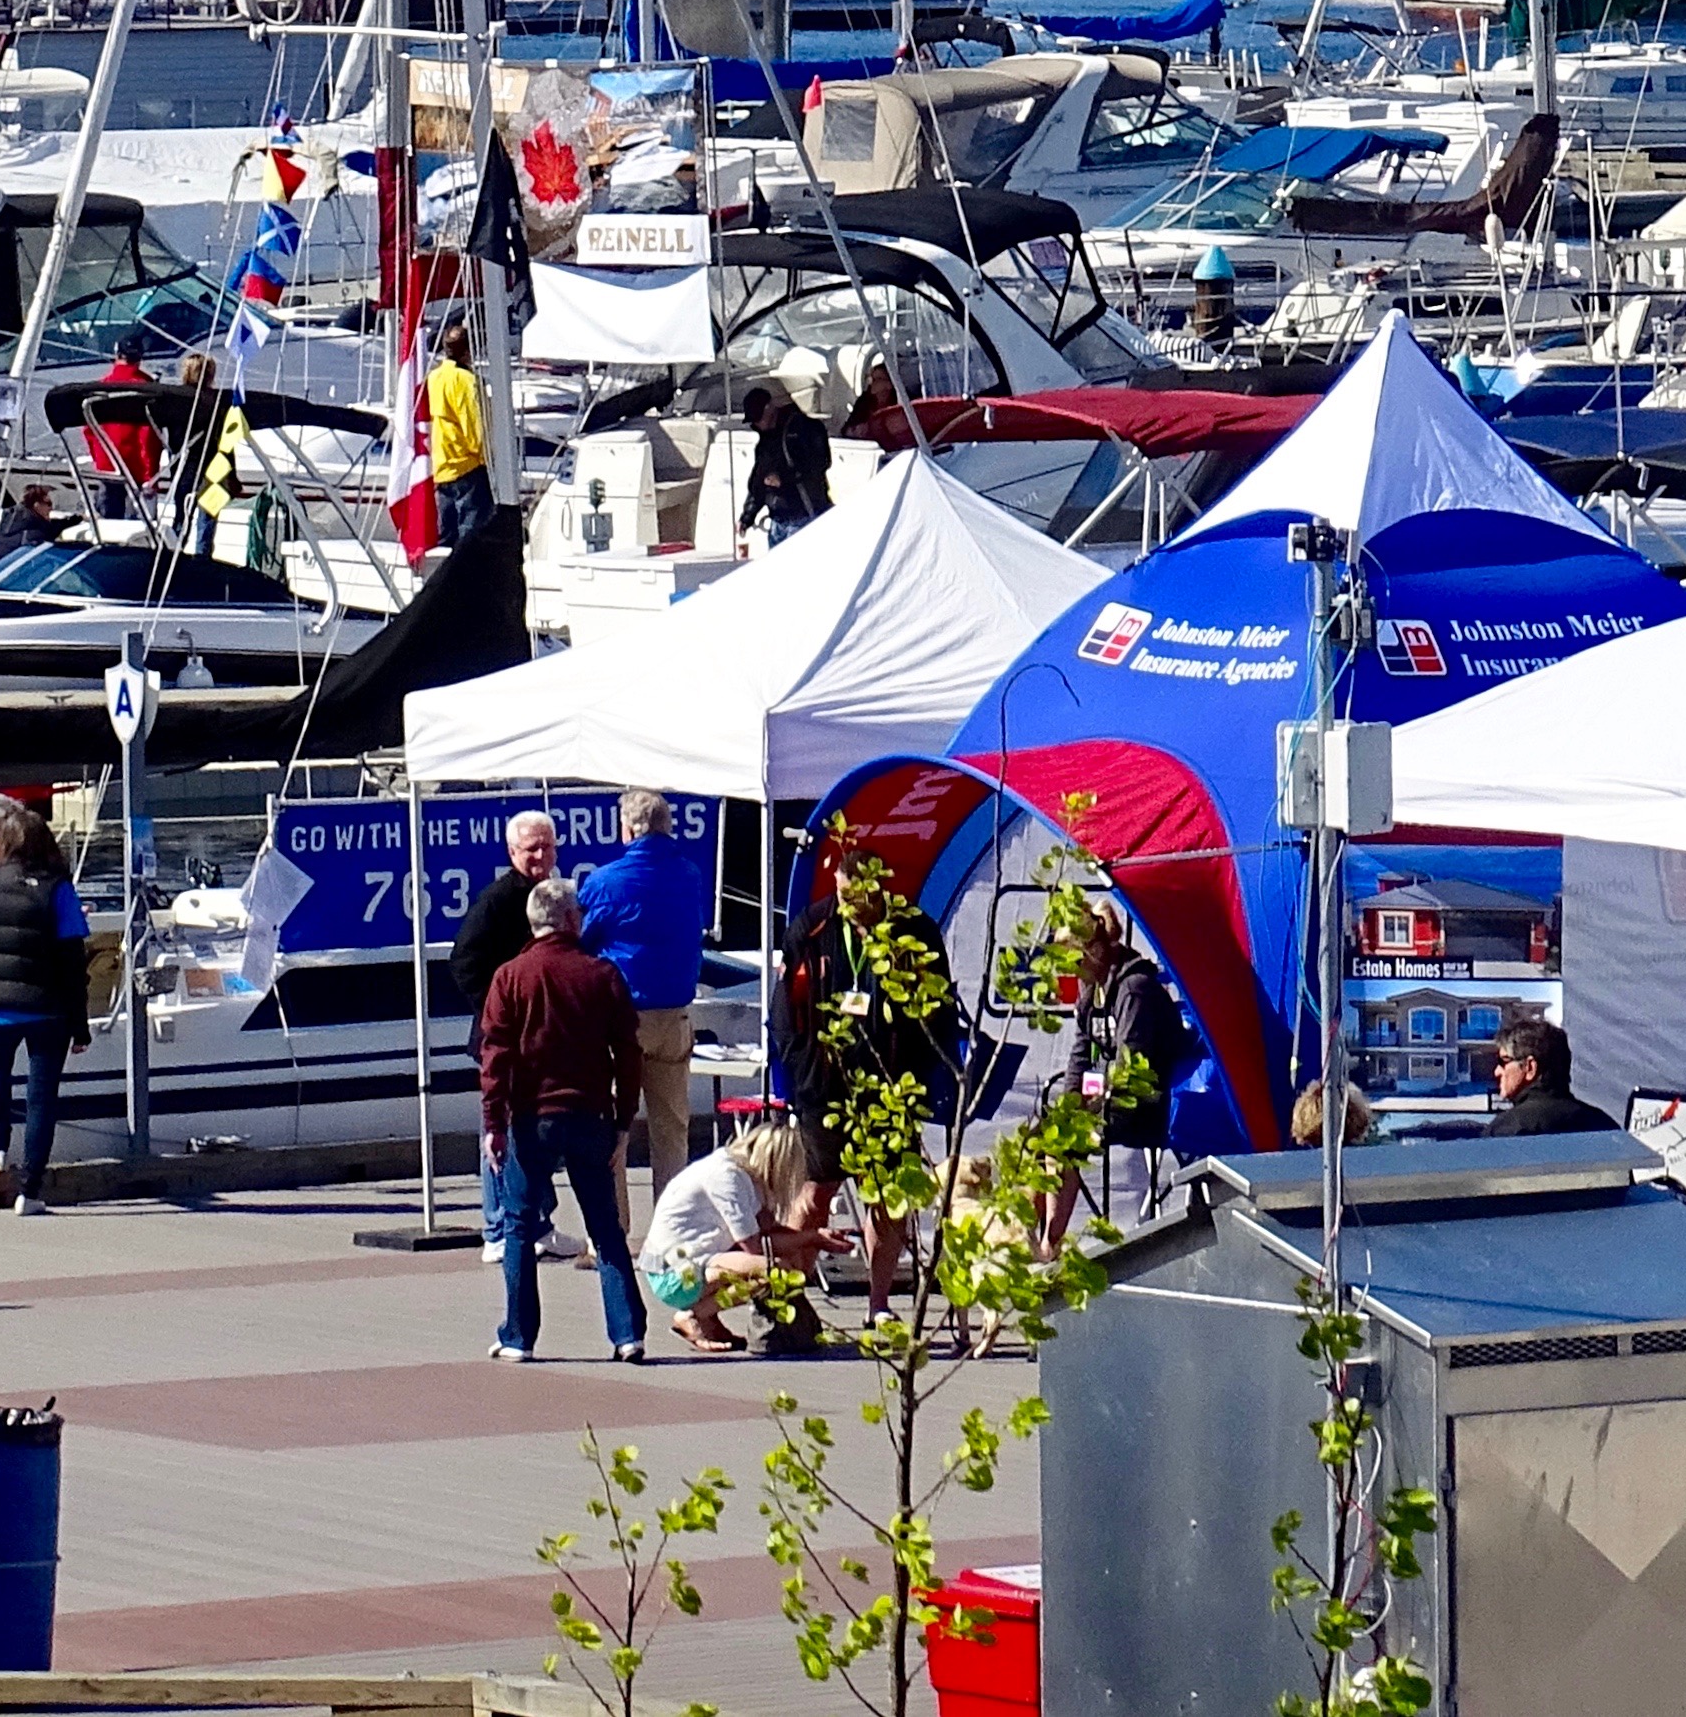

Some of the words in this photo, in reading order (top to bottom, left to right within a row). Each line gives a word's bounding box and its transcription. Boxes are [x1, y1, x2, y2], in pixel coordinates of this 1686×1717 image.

[417, 69, 515, 101] REINL
[588, 227, 694, 254] REINELL
[1151, 615, 1235, 648] Johnston
[1232, 623, 1290, 648] Meier
[1449, 618, 1565, 643] Johnston
[1565, 612, 1644, 638] Meier
[1129, 646, 1221, 677] Insurance
[1216, 654, 1298, 685] Agencies
[1460, 653, 1569, 676] Insuran
[115, 678, 134, 718] A
[291, 825, 325, 852] GO
[335, 822, 402, 851] WITH
[420, 818, 461, 846] HE
[469, 815, 513, 845] WI
[549, 801, 708, 846] CRUES
[1352, 957, 1392, 977] Estate
[1395, 957, 1440, 978] Homes
